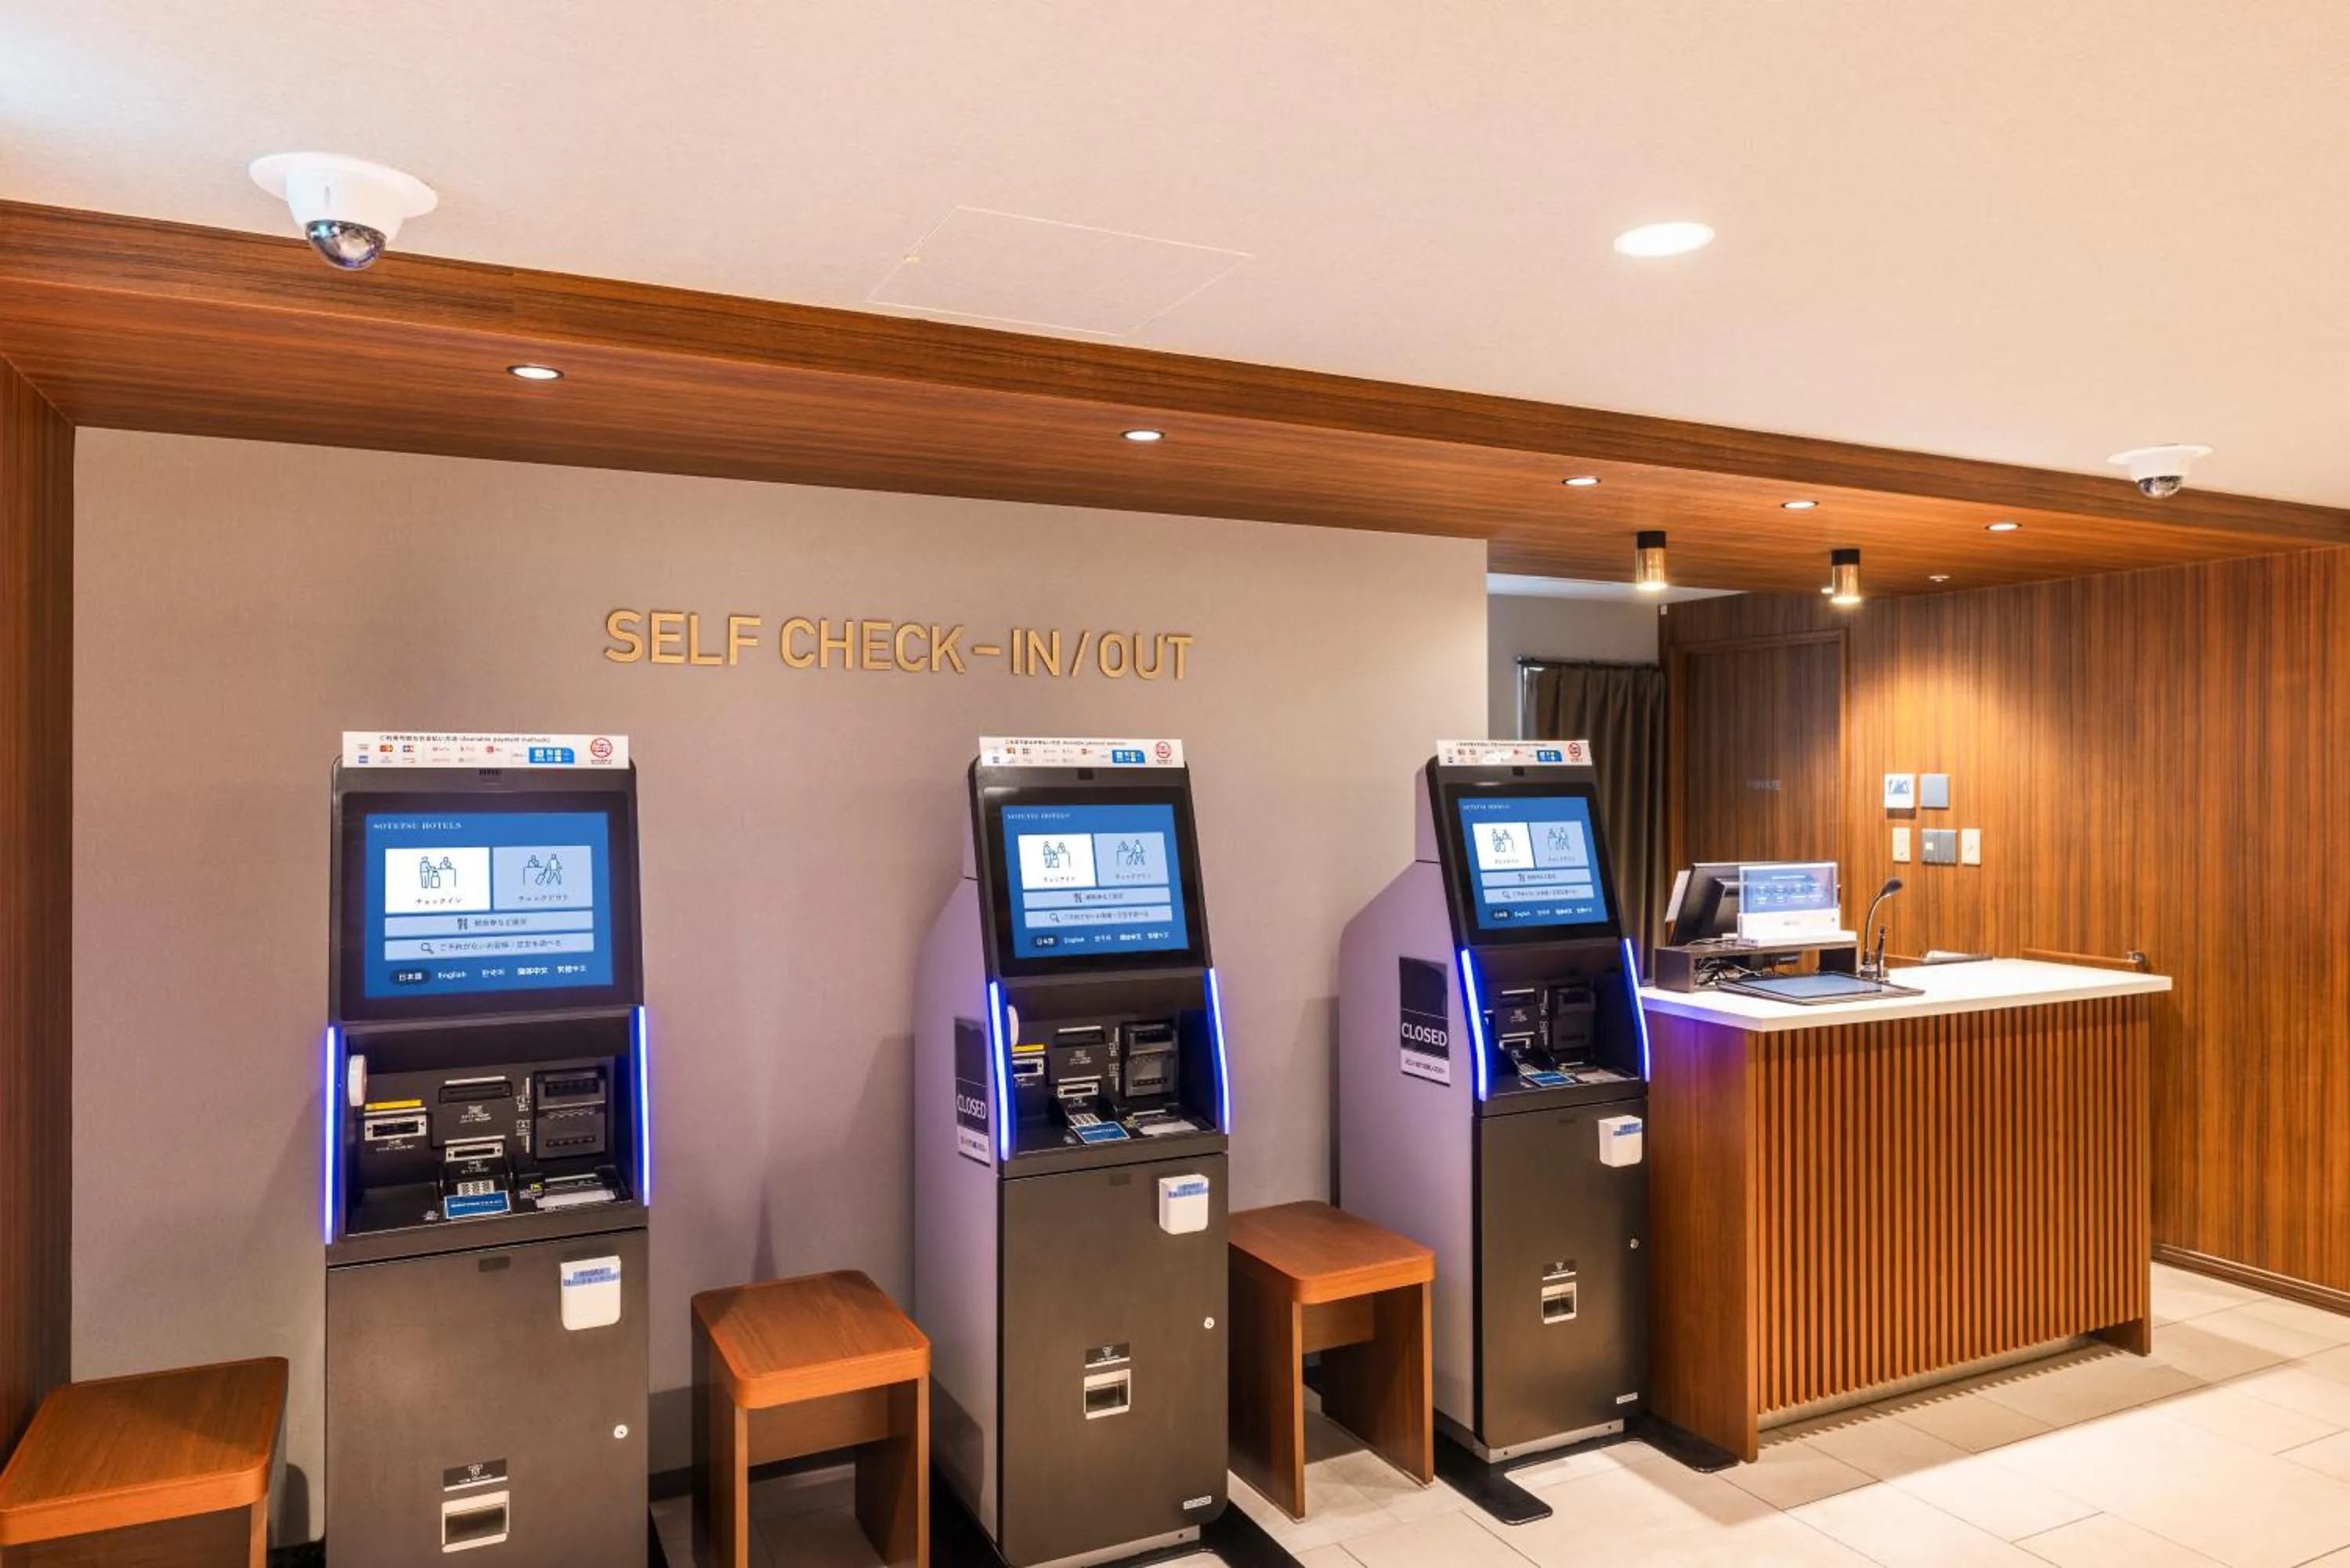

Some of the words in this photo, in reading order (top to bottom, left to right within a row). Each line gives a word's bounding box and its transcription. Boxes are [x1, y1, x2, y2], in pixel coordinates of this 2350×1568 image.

[603, 609, 761, 667] SELF
[780, 617, 1194, 681] CHECK-IN/OUT
[399, 972, 423, 981] 日本語
[438, 970, 468, 980] English
[1402, 1022, 1448, 1047] CLOSED
[956, 1093, 986, 1120] CLOSED
